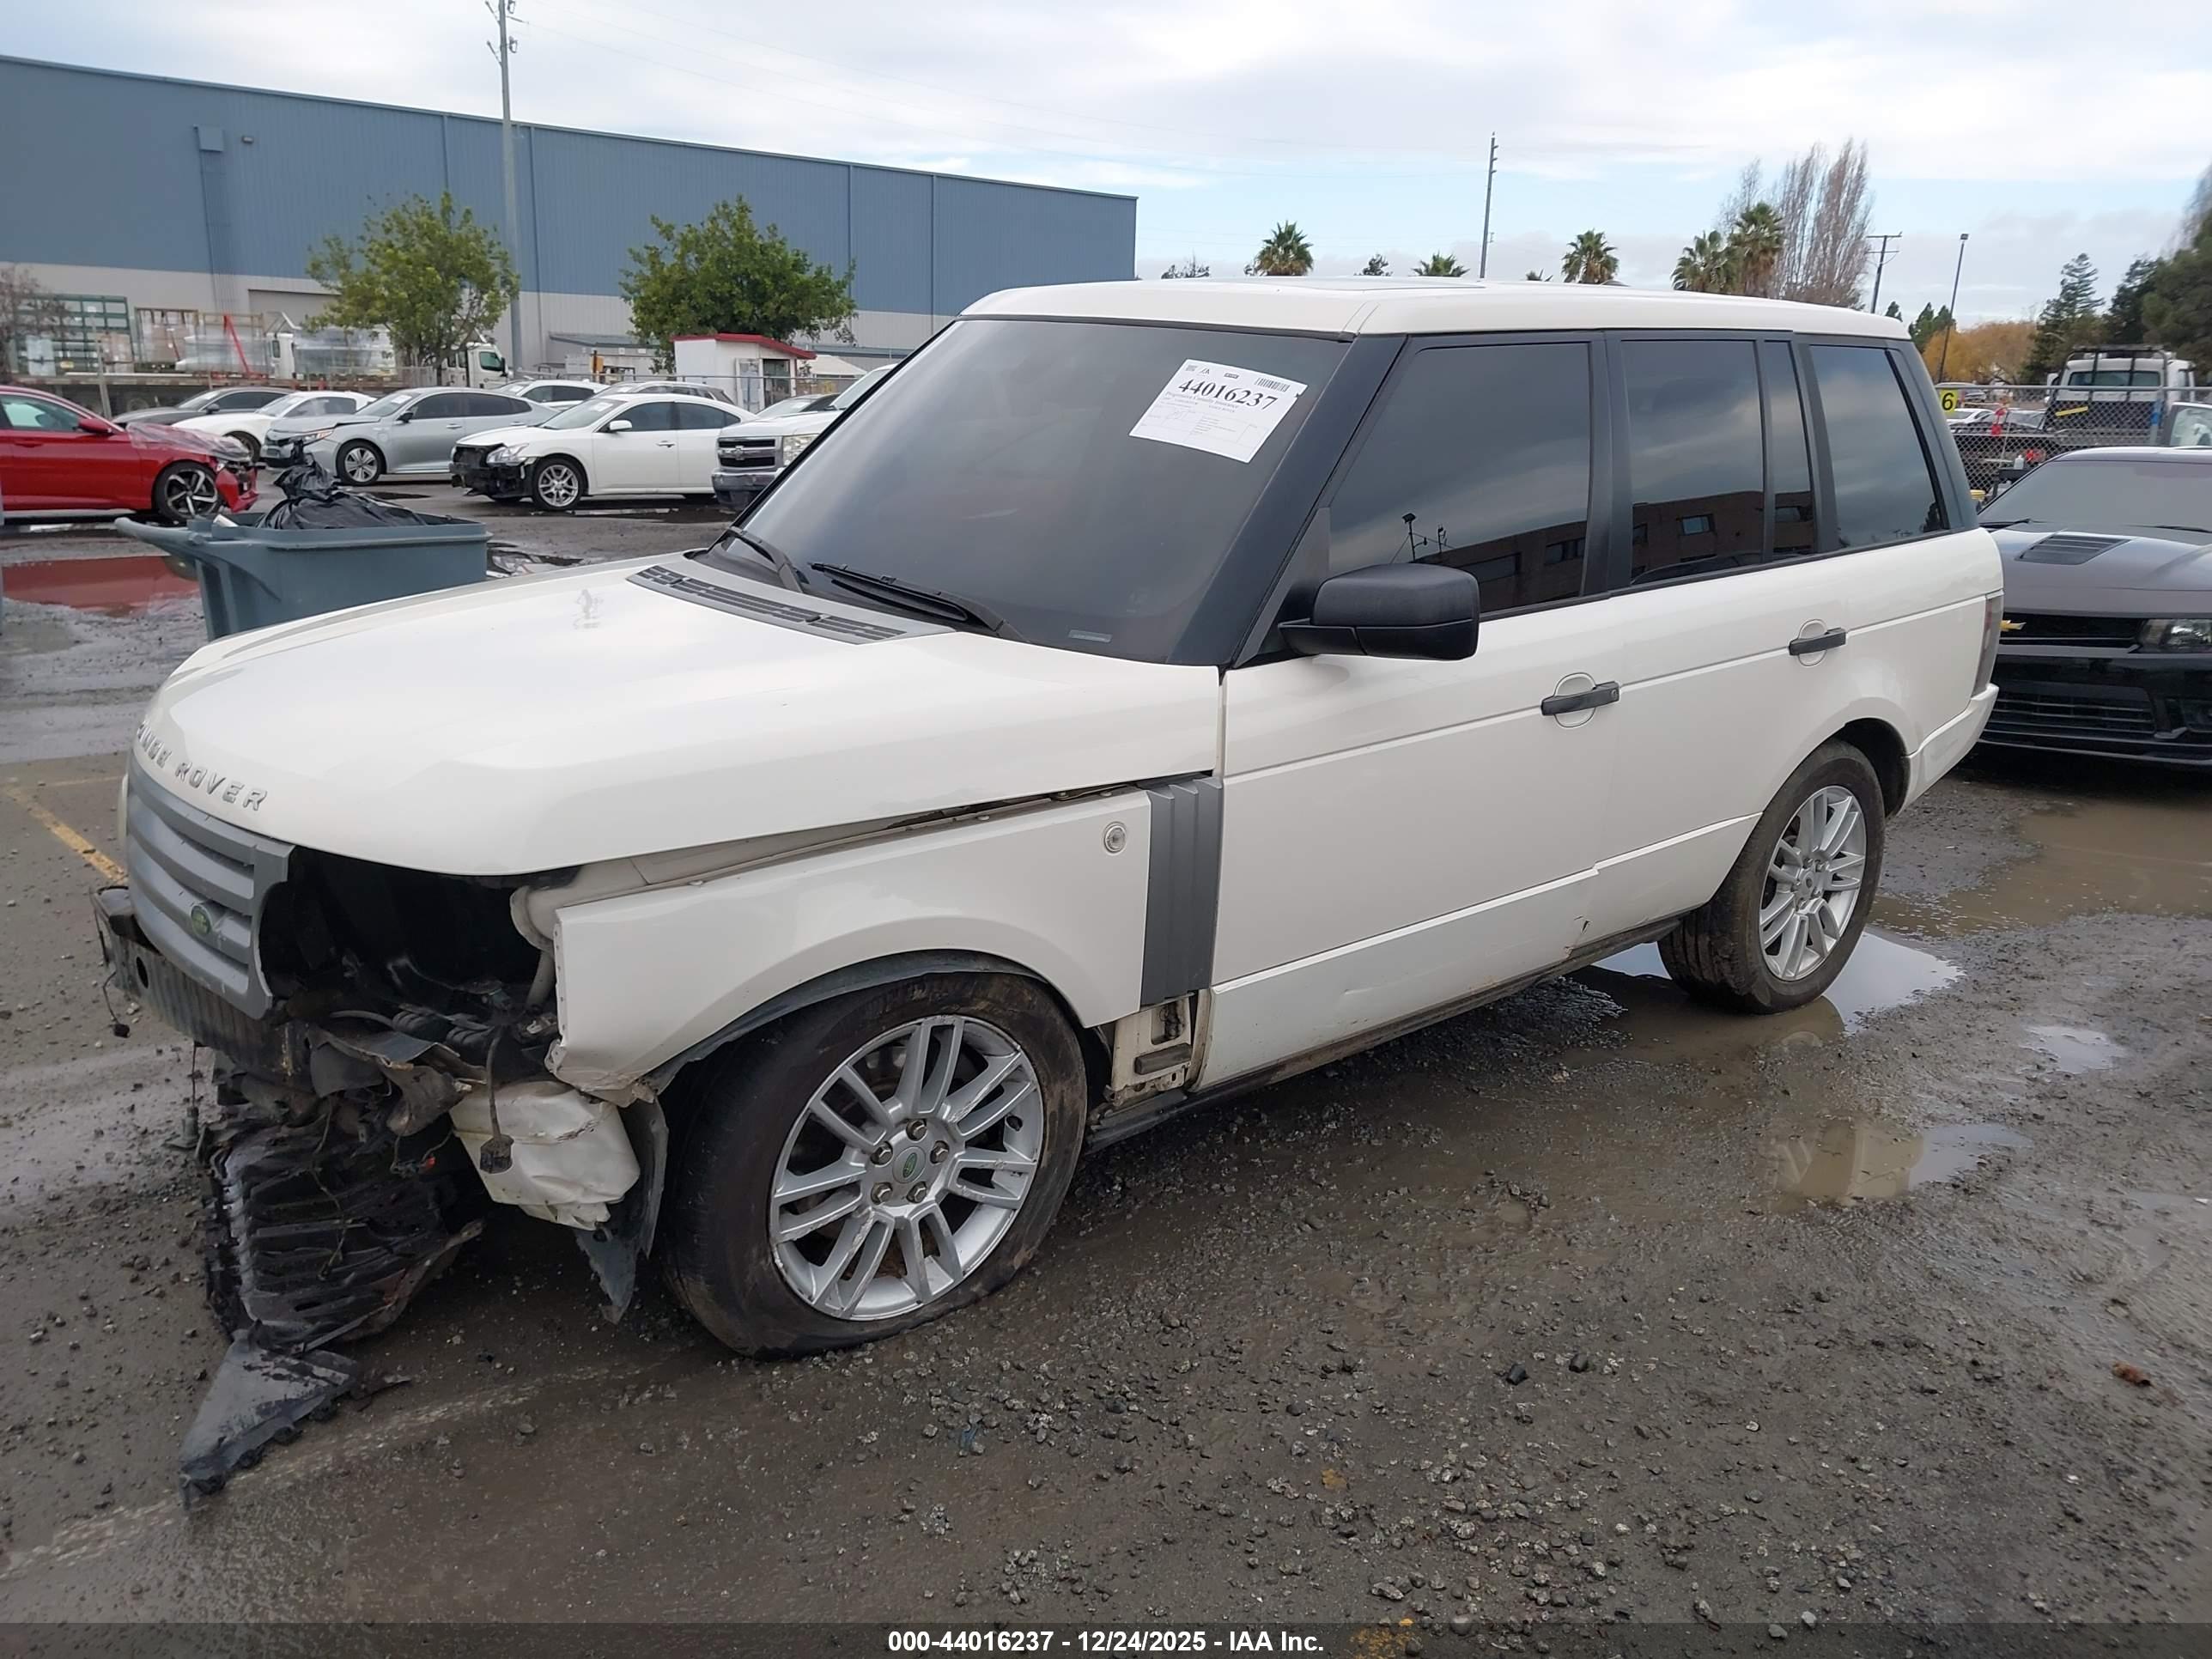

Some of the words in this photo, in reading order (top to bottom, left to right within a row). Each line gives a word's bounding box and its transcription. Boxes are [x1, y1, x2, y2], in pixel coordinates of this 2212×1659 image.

[1177, 378, 1279, 410] 44016237
[1942, 392, 1954, 411] 6
[174, 761, 268, 811] ROVER
